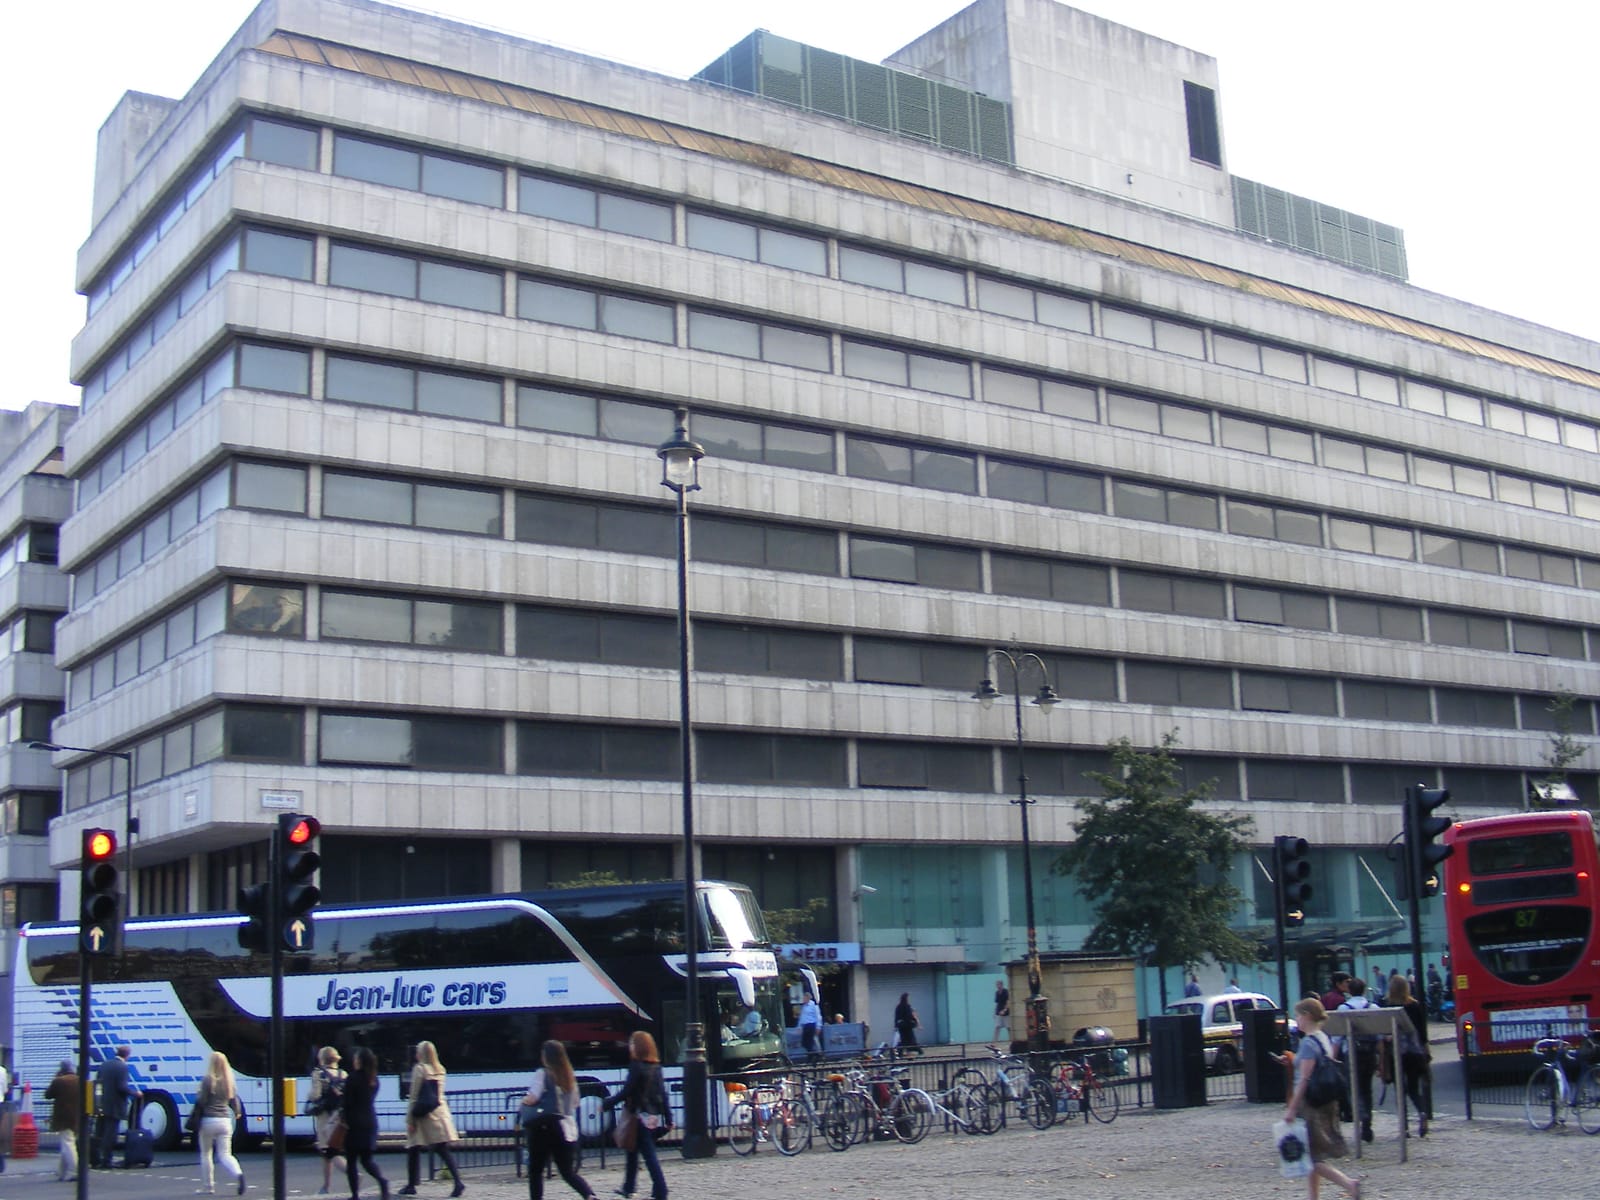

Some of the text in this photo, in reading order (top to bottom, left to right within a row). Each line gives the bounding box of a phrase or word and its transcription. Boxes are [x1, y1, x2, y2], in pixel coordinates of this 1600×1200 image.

[1515, 909, 1537, 928] 87
[317, 976, 507, 1011] Jean-luc cars
